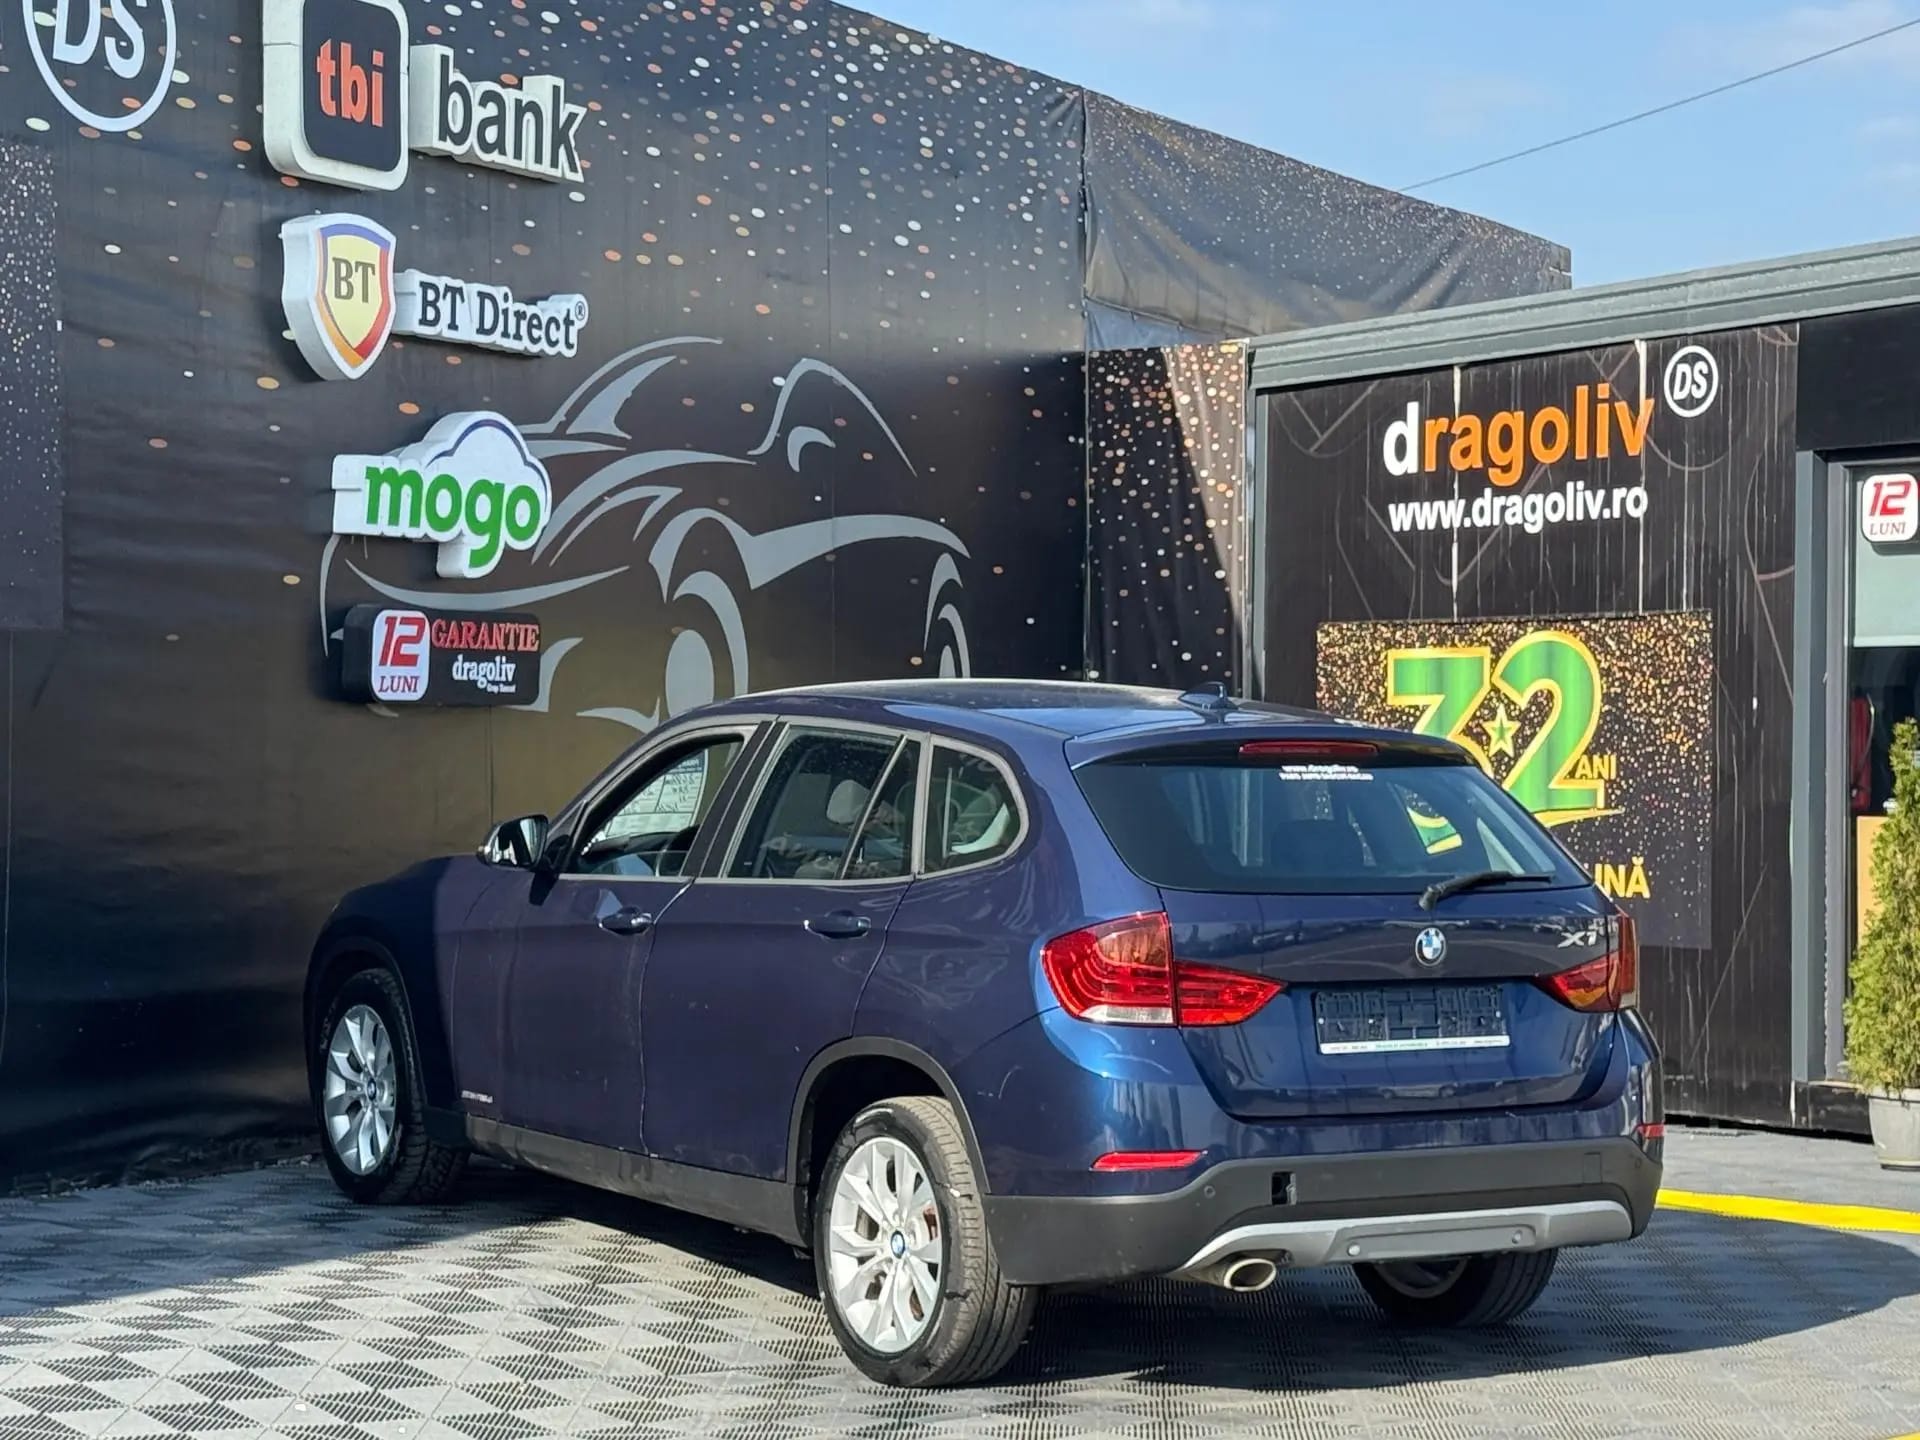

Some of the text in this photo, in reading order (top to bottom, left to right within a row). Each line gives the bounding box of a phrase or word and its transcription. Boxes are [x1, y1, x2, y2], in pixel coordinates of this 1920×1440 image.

[53, 0, 147, 79] DS
[316, 38, 384, 127] tbi
[437, 53, 580, 174] bank
[332, 257, 375, 303] BT
[418, 280, 465, 331] BT
[1673, 361, 1708, 400] DS
[1383, 383, 1655, 486] dragoliv
[365, 465, 541, 568] mogo
[1388, 480, 1648, 534] www.dragoliv.ro
[1869, 480, 1911, 516] 12
[1869, 522, 1906, 536] LUNI
[378, 616, 426, 667] 12
[431, 618, 540, 652] GARANTIE
[378, 675, 420, 693] LUNI
[452, 653, 517, 689] dragoliv
[1574, 753, 1617, 781] ANI
